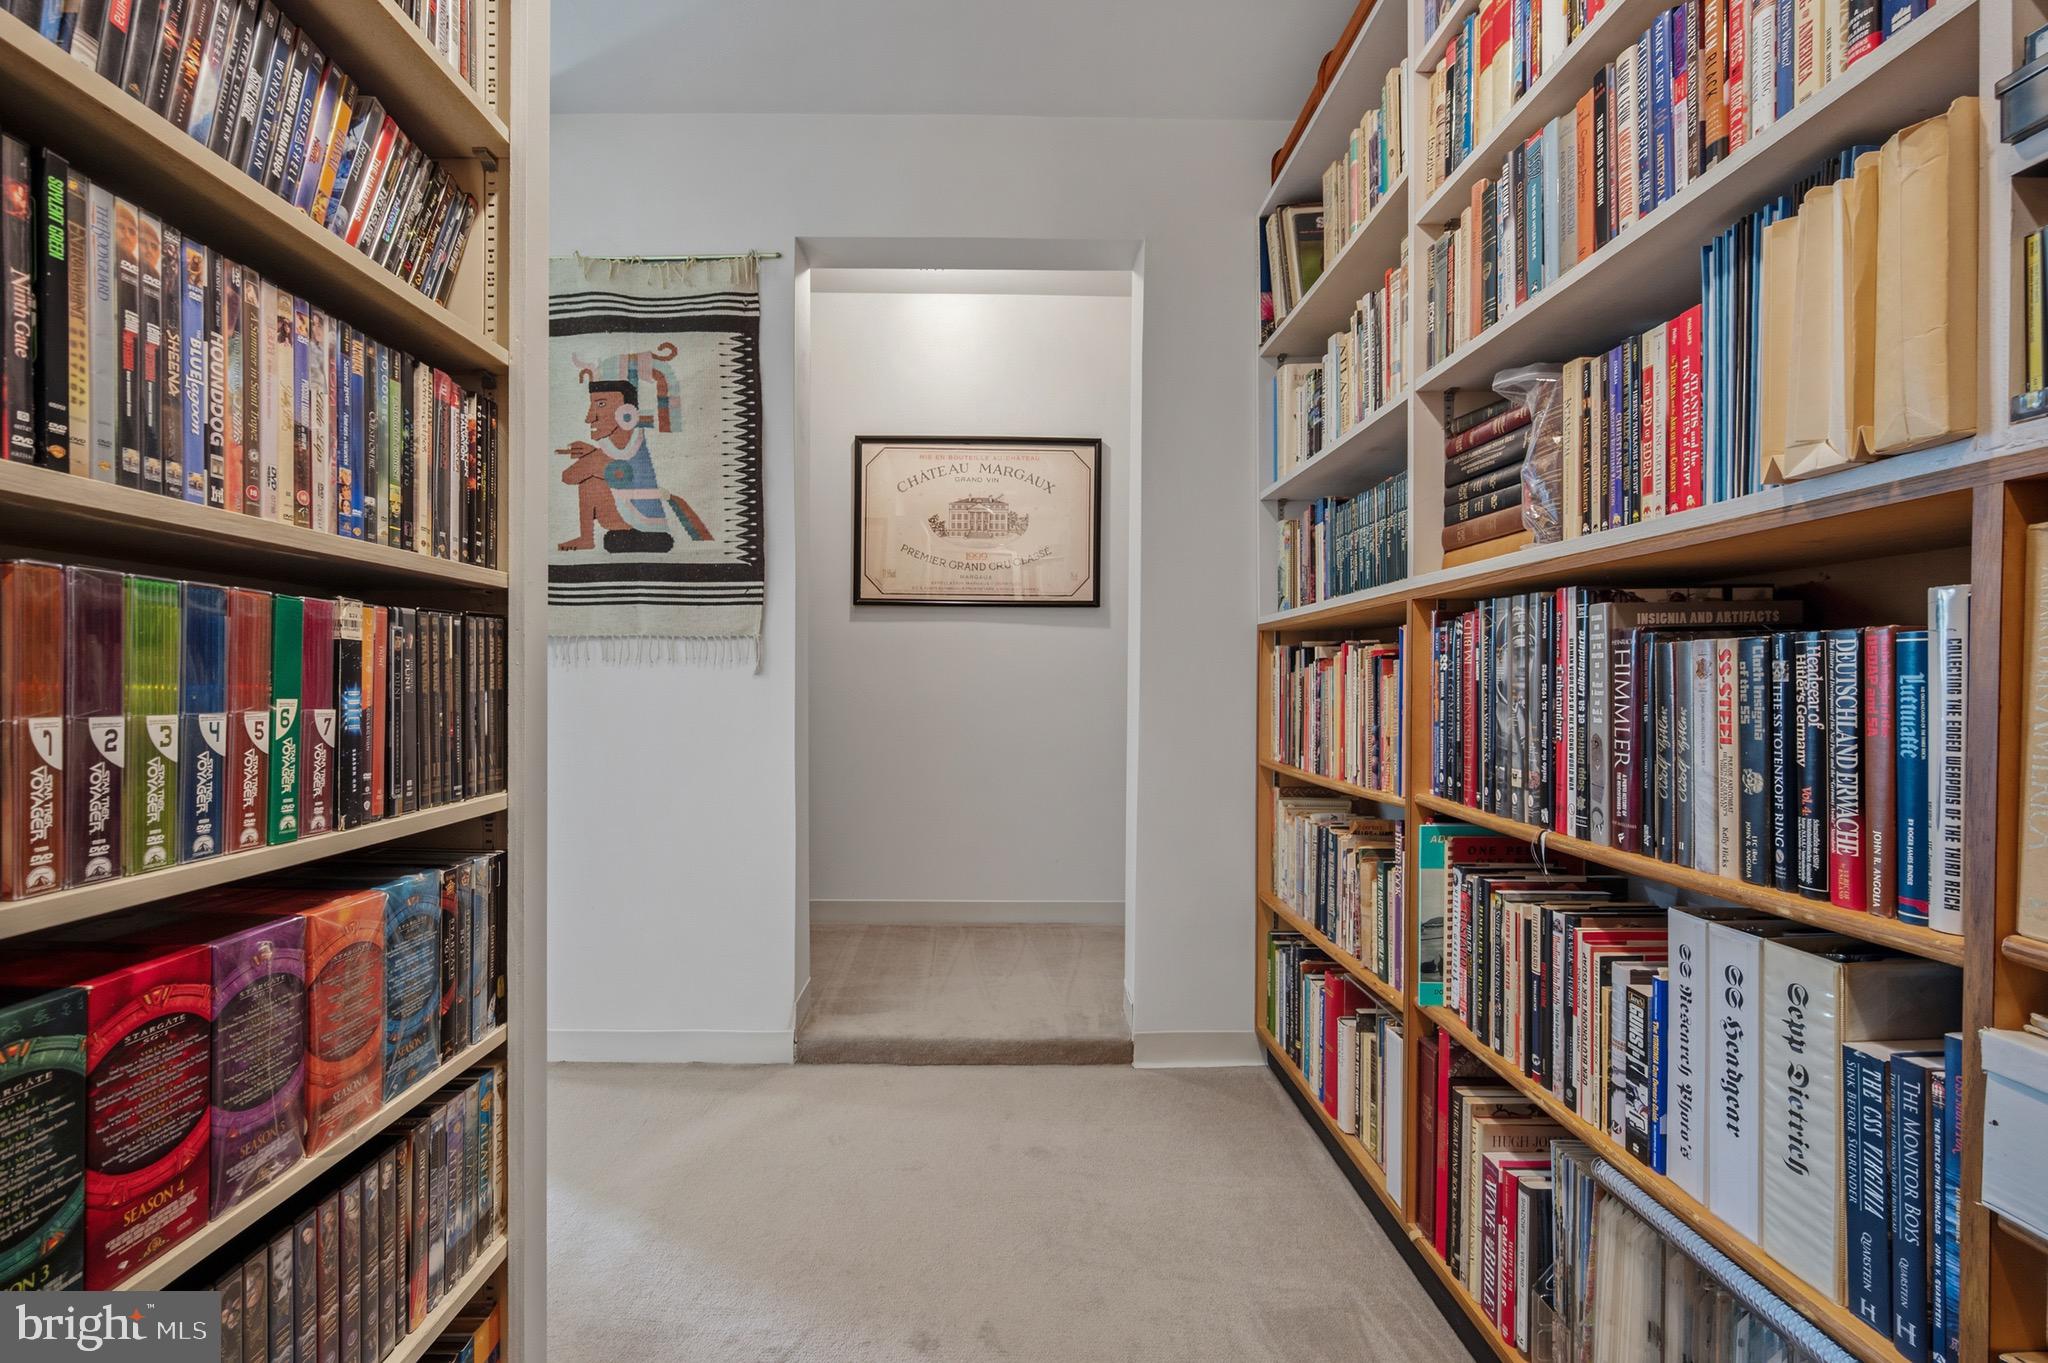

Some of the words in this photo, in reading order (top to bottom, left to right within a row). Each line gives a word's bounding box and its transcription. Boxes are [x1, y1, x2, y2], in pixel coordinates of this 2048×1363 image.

[1687, 14, 1696, 57] LIBERTY
[1781, 3, 1791, 28] WENT
[1654, 18, 1664, 56] MARK
[1730, 30, 1743, 65] PRESS
[1762, 15, 1771, 96] REDISCOVERING
[1782, 30, 1791, 68] WRONG?
[1798, 20, 1813, 86] AMERICA
[1637, 38, 1648, 100] PLUNDER
[1655, 57, 1664, 68] R.
[266, 58, 285, 114] WONDER
[286, 69, 303, 113] WONDER
[1655, 72, 1665, 103] LEVIN
[1688, 61, 1696, 138] AMENDMENTS
[254, 119, 271, 170] WOMAN
[276, 114, 293, 156] WOMAN
[1618, 127, 1632, 175] AMERICAN
[1638, 109, 1648, 159] DECEIT
[272, 153, 285, 178] 1984
[370, 159, 381, 176] THE
[1597, 156, 1603, 167] TO
[1656, 133, 1665, 198] AMERITOPIA
[48, 176, 63, 226] SOYLENT
[354, 175, 376, 222] HAWAIIANS
[1620, 175, 1632, 220] MARXISM
[48, 224, 64, 260] GREEN
[10, 267, 30, 318] Ninth
[250, 311, 258, 323] A
[13, 321, 30, 358] Gate
[250, 325, 259, 365] Summer
[166, 329, 180, 398] SHEENA
[250, 367, 259, 379] in
[1682, 356, 1690, 384] TEN
[210, 331, 224, 447] HOUNDDOG
[250, 381, 259, 407] Saint
[1691, 373, 1699, 428] ATLANTIS
[249, 409, 259, 442] Tropez
[1582, 416, 1590, 444] Moses
[1682, 386, 1690, 435] PLAGUES
[1682, 438, 1690, 448] of
[979, 463, 1056, 494] MARGAUX
[1682, 450, 1691, 488] EGYPT
[1582, 470, 1590, 513] Akhenaten
[900, 544, 947, 567] PREMIER
[949, 561, 986, 571] GRAND
[989, 560, 1011, 571] CRU
[1636, 611, 1688, 626] INSIGNIA
[1690, 611, 1713, 623] AND
[1716, 610, 1779, 623] ARTIFACTS
[1752, 645, 1764, 682] Cloth
[1796, 653, 1806, 703] Hitler's
[1805, 645, 1822, 713] Headgear
[1867, 635, 1877, 683] NSDAP
[1946, 638, 1962, 695] COLLECTING
[1614, 649, 1631, 768] HIMMLER
[1718, 648, 1733, 750] SS-STEEL
[1751, 685, 1765, 741] Insignia
[1773, 683, 1782, 710] THE
[1835, 638, 1858, 769] DEUTSCHLAND
[1867, 688, 1877, 713] and
[1899, 672, 1924, 759] Luftwaffe
[1946, 699, 1962, 716] THE
[160, 726, 172, 747] 3
[209, 722, 220, 742] 4
[255, 721, 264, 740] 5
[280, 708, 290, 728] 6
[324, 718, 331, 736] 7
[1774, 713, 1783, 727] SS
[1796, 704, 1806, 768] Germany
[1807, 715, 1825, 730] of
[1867, 717, 1878, 737] SA
[1946, 720, 1962, 752] EDGED
[105, 729, 118, 752] 2
[1577, 727, 1586, 765] Dietrich
[102, 770, 110, 795] STAR
[196, 751, 207, 816] VOYAGER
[243, 748, 253, 809] VOYAGER
[281, 737, 291, 794] VOYAGER
[313, 743, 321, 798] VOYAGER
[1577, 768, 1586, 792] Sepp
[1774, 732, 1784, 810] TOTENKOPF
[1945, 756, 1961, 805] WEAPONS
[30, 765, 45, 843] VOYAGER
[45, 775, 53, 800] STAR
[89, 761, 102, 835] VOYAGER
[102, 796, 110, 820] TREK
[146, 757, 158, 825] VOYAGER
[45, 802, 53, 828] TREK
[1643, 824, 1651, 846] amber
[1774, 813, 1784, 848] RING
[1836, 772, 1859, 856] ERWACHE
[1945, 808, 1961, 821] OF
[1945, 824, 1961, 843] THE
[1394, 832, 1402, 864] HERB
[1721, 846, 1729, 868] Hicks
[1945, 847, 1961, 877] THIRD
[1944, 880, 1960, 911] REICH
[1679, 944, 1691, 979] SS
[1725, 965, 1743, 1011] SS
[123, 1014, 186, 1043] STARGATE
[1629, 1002, 1645, 1049] GUNS
[1678, 984, 1692, 1076] Research
[1781, 983, 1809, 1054] Sepp
[1720, 1016, 1744, 1138] Headgear
[1846, 1060, 1856, 1090] SINK
[1862, 1068, 1882, 1103] THE
[1847, 1093, 1856, 1135] BEFORE
[1903, 1080, 1920, 1114] THE
[1676, 1084, 1692, 1160] Photo's
[1783, 1062, 1810, 1176] Dietrich
[1864, 1106, 1881, 1137] CSS
[1492, 1134, 1527, 1148] HUGH
[1903, 1116, 1920, 1197] MONITOR
[418, 1149, 426, 1201] ODYSSEY
[1847, 1138, 1858, 1204] SURRENDER
[1864, 1142, 1884, 1220] VIRGINIA
[123, 1189, 174, 1227] SEASON
[176, 1179, 184, 1192] 4
[1484, 1177, 1496, 1234] WINE
[1904, 1202, 1920, 1246] BOYS
[1484, 1245, 1496, 1312] BIBLE
[1861, 1232, 1873, 1292] QUARSTEIN
[1899, 1257, 1909, 1309] QUARSTEIN
